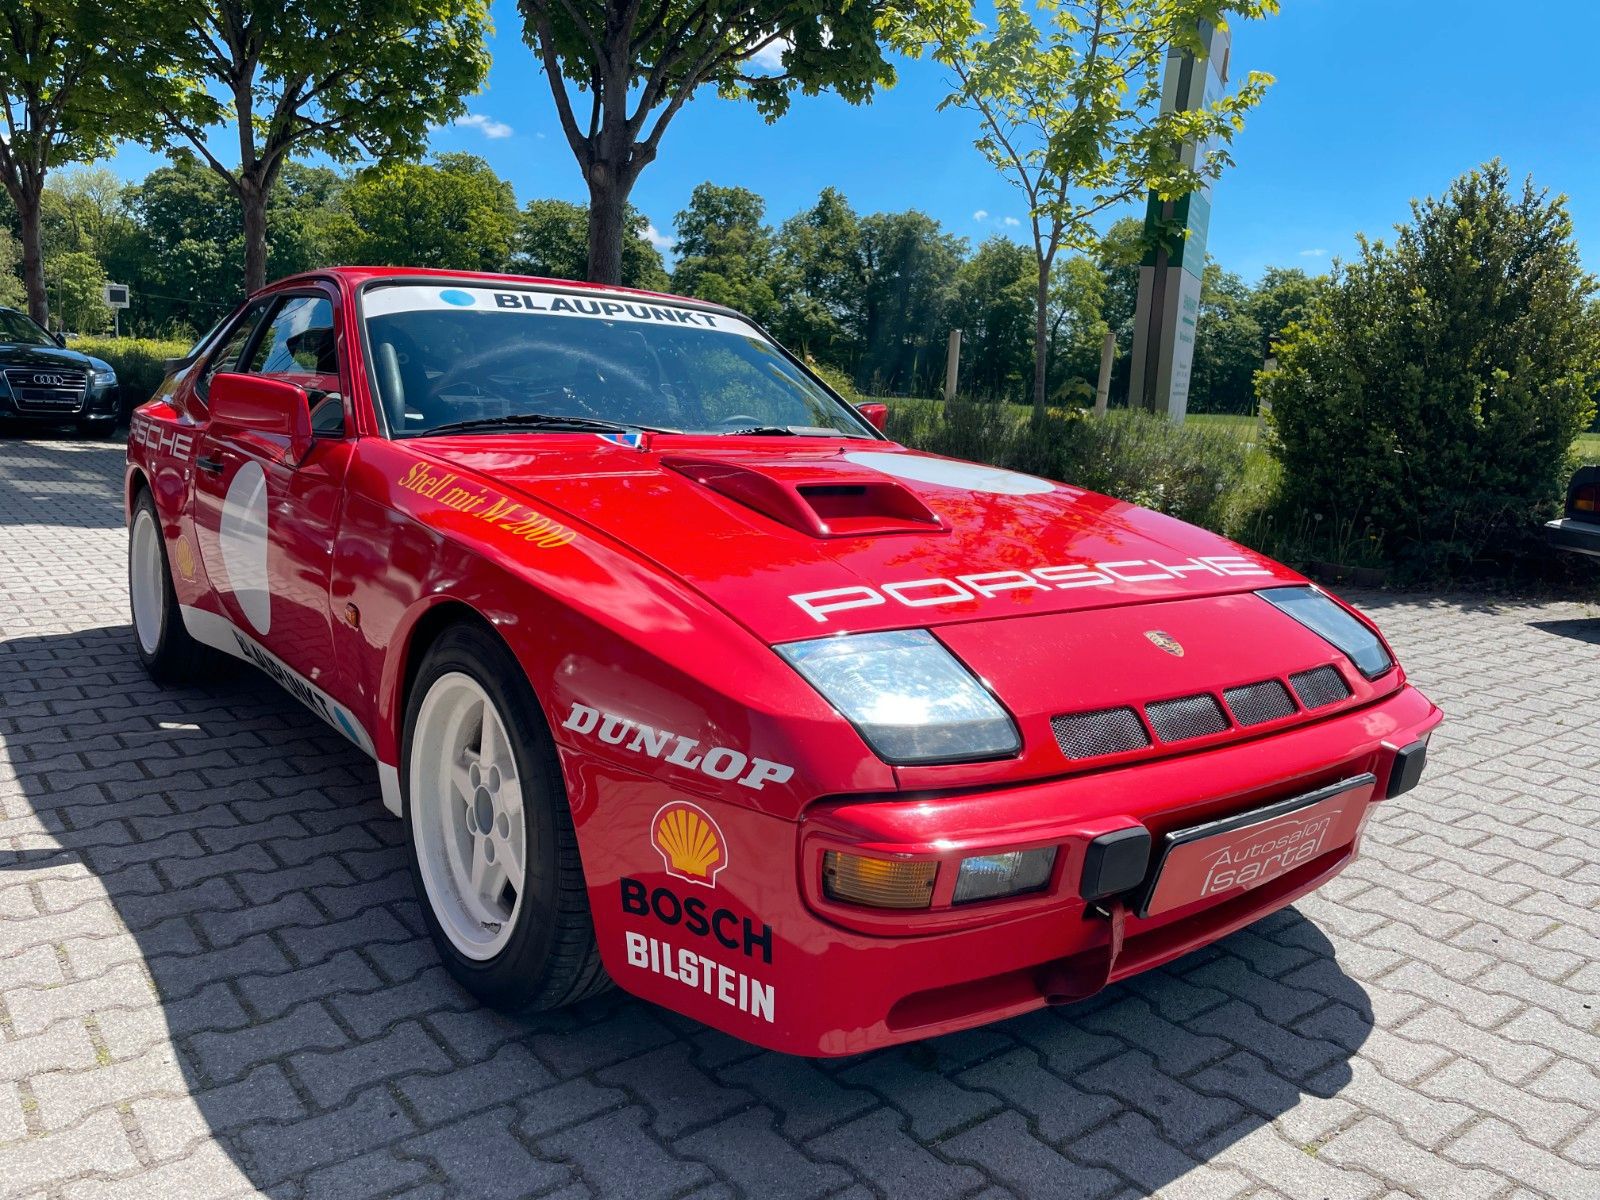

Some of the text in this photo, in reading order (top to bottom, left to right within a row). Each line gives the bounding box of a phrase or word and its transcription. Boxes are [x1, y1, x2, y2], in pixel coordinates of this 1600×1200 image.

[494, 293, 718, 328] BLAUPUNKT
[398, 461, 459, 499] Shell
[437, 487, 488, 512] mit
[788, 556, 1272, 622] PORSCHE
[561, 702, 795, 790] DUNLOP
[1201, 829, 1327, 896] Isartal
[1211, 817, 1331, 869] Autosalon
[620, 877, 773, 965] BOSCH
[625, 931, 775, 1024] BILSTEIN
